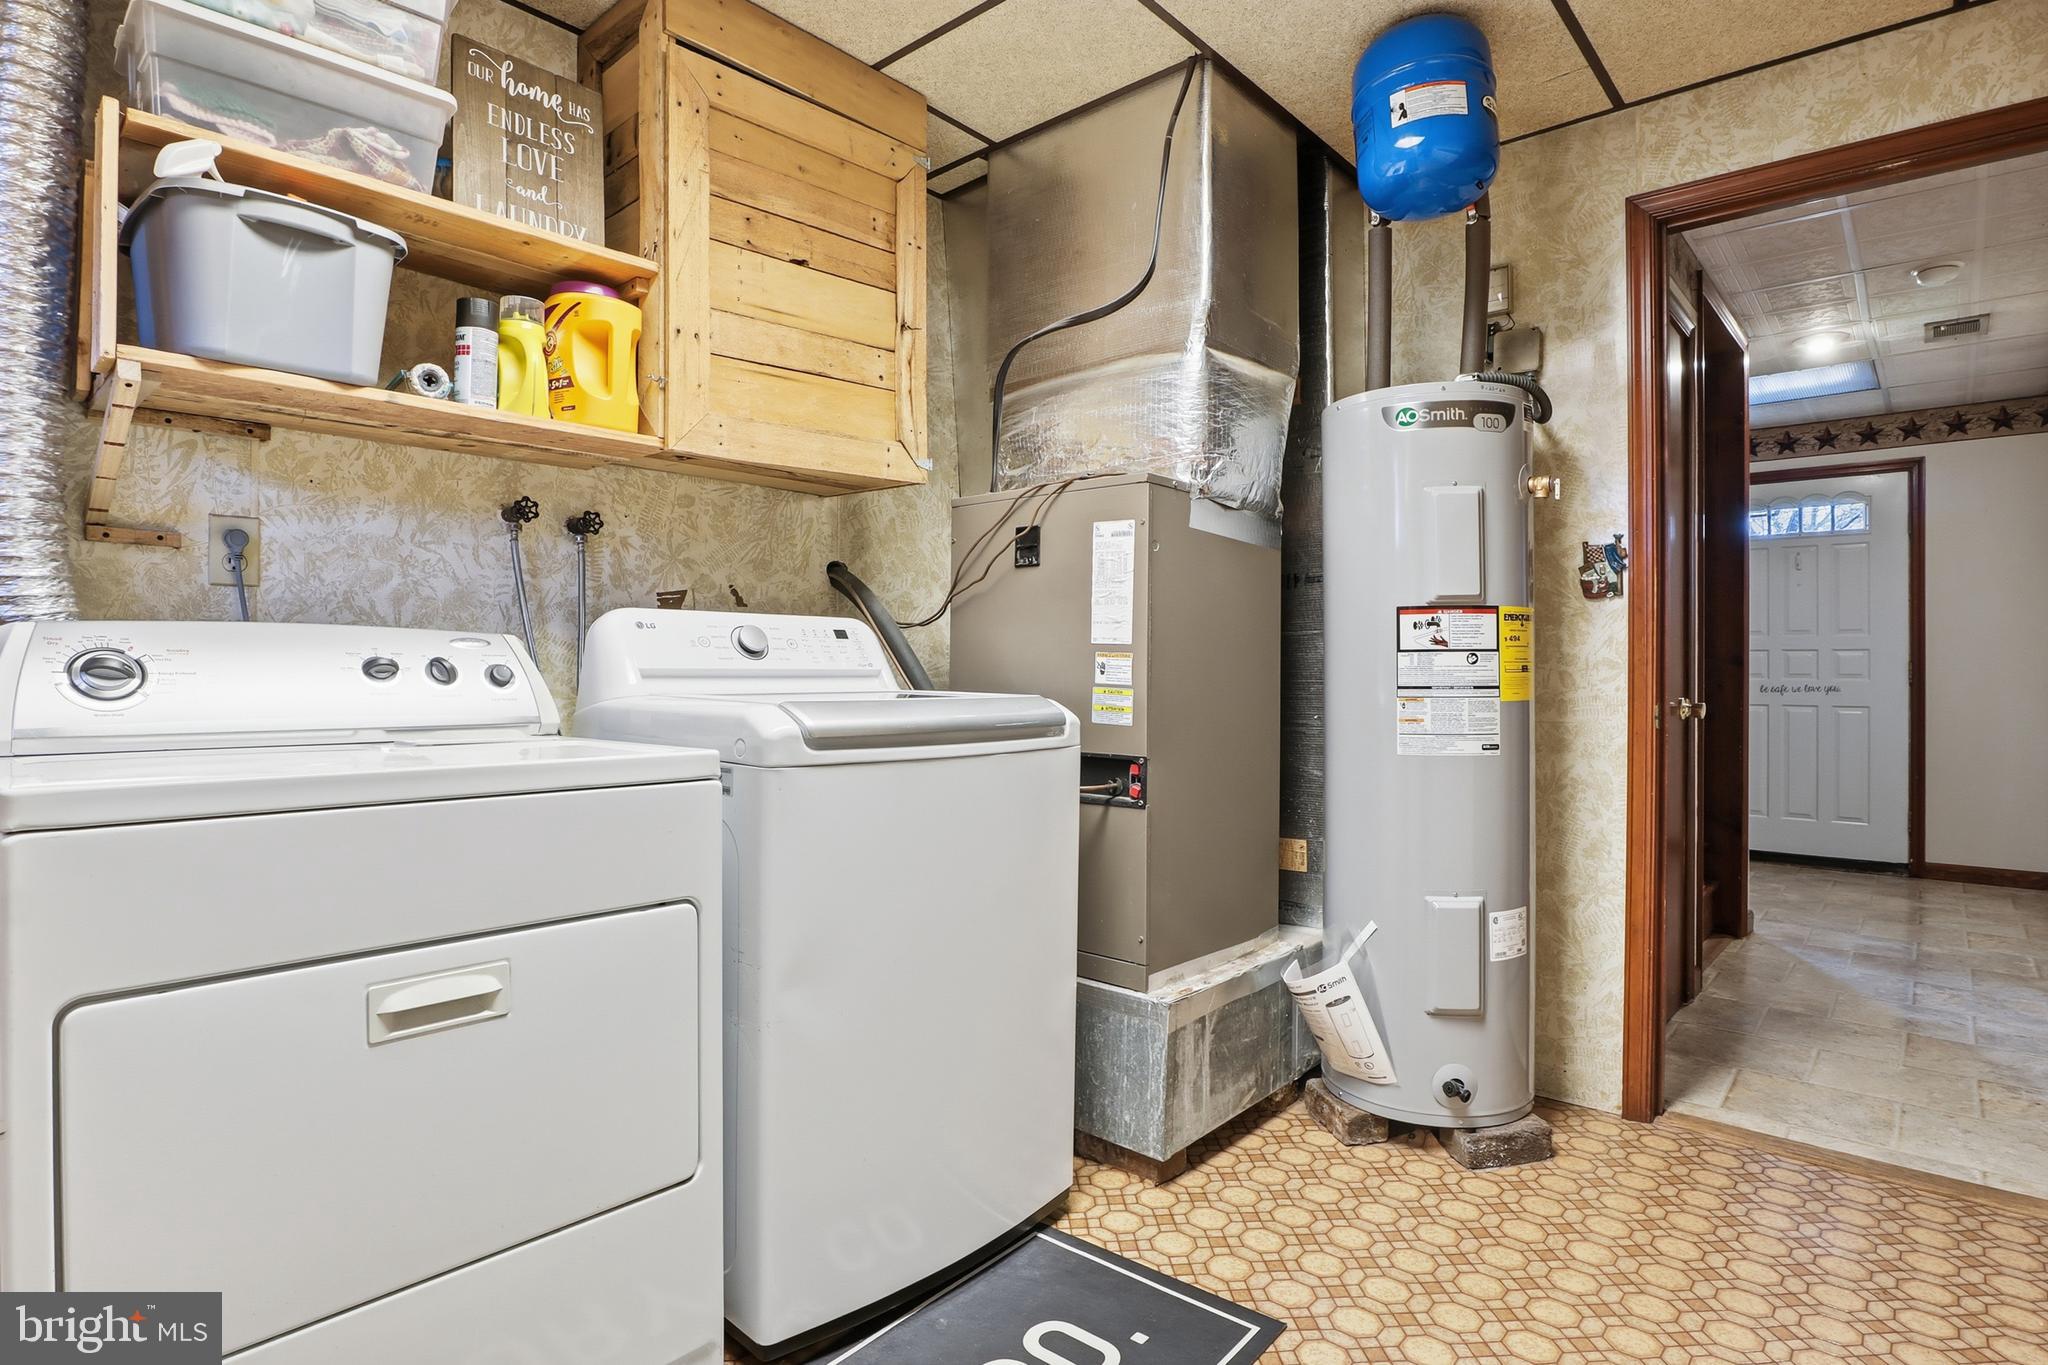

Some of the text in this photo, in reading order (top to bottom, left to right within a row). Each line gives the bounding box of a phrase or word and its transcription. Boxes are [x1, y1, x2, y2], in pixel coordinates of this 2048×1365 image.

[467, 61, 494, 84] OUR
[568, 102, 591, 122] HAS
[487, 102, 576, 155] ENDLESS
[501, 137, 565, 183] LOVE
[1481, 416, 1500, 430] 100
[1760, 684, 1769, 693] be
[1791, 685, 1802, 693] we
[1804, 684, 1822, 693] love
